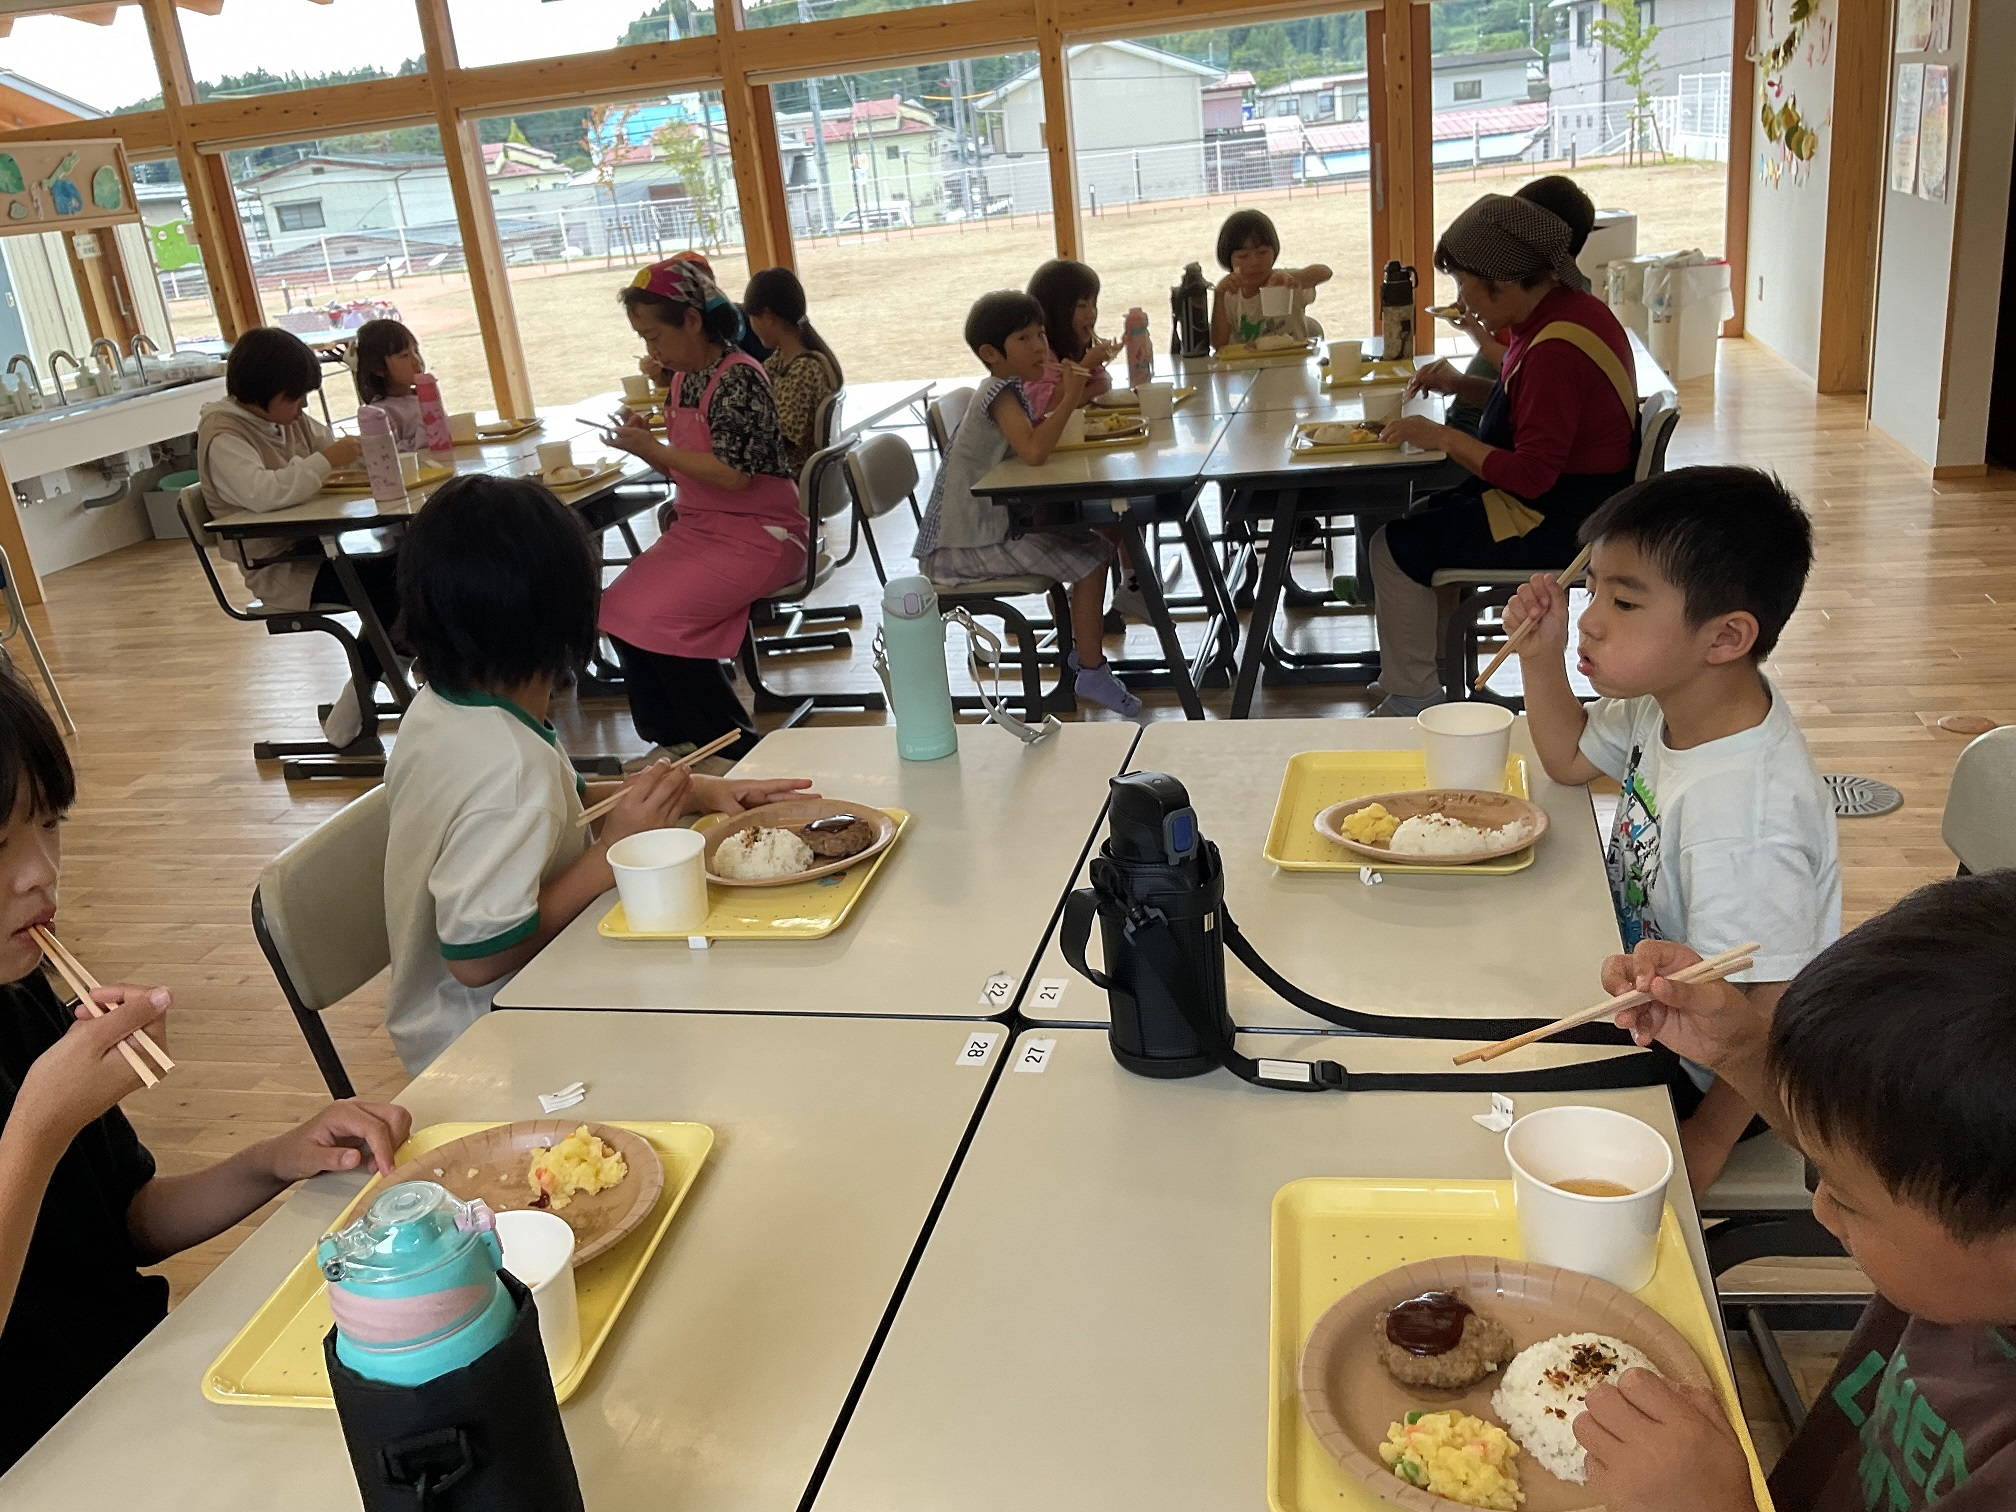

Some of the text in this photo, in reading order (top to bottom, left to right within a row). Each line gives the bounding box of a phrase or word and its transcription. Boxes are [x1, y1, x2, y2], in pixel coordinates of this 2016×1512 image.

[989, 982, 1009, 997] 22
[1039, 986, 1060, 1000] 21
[967, 1041, 989, 1058] 28
[1024, 1047, 1046, 1064] 27
